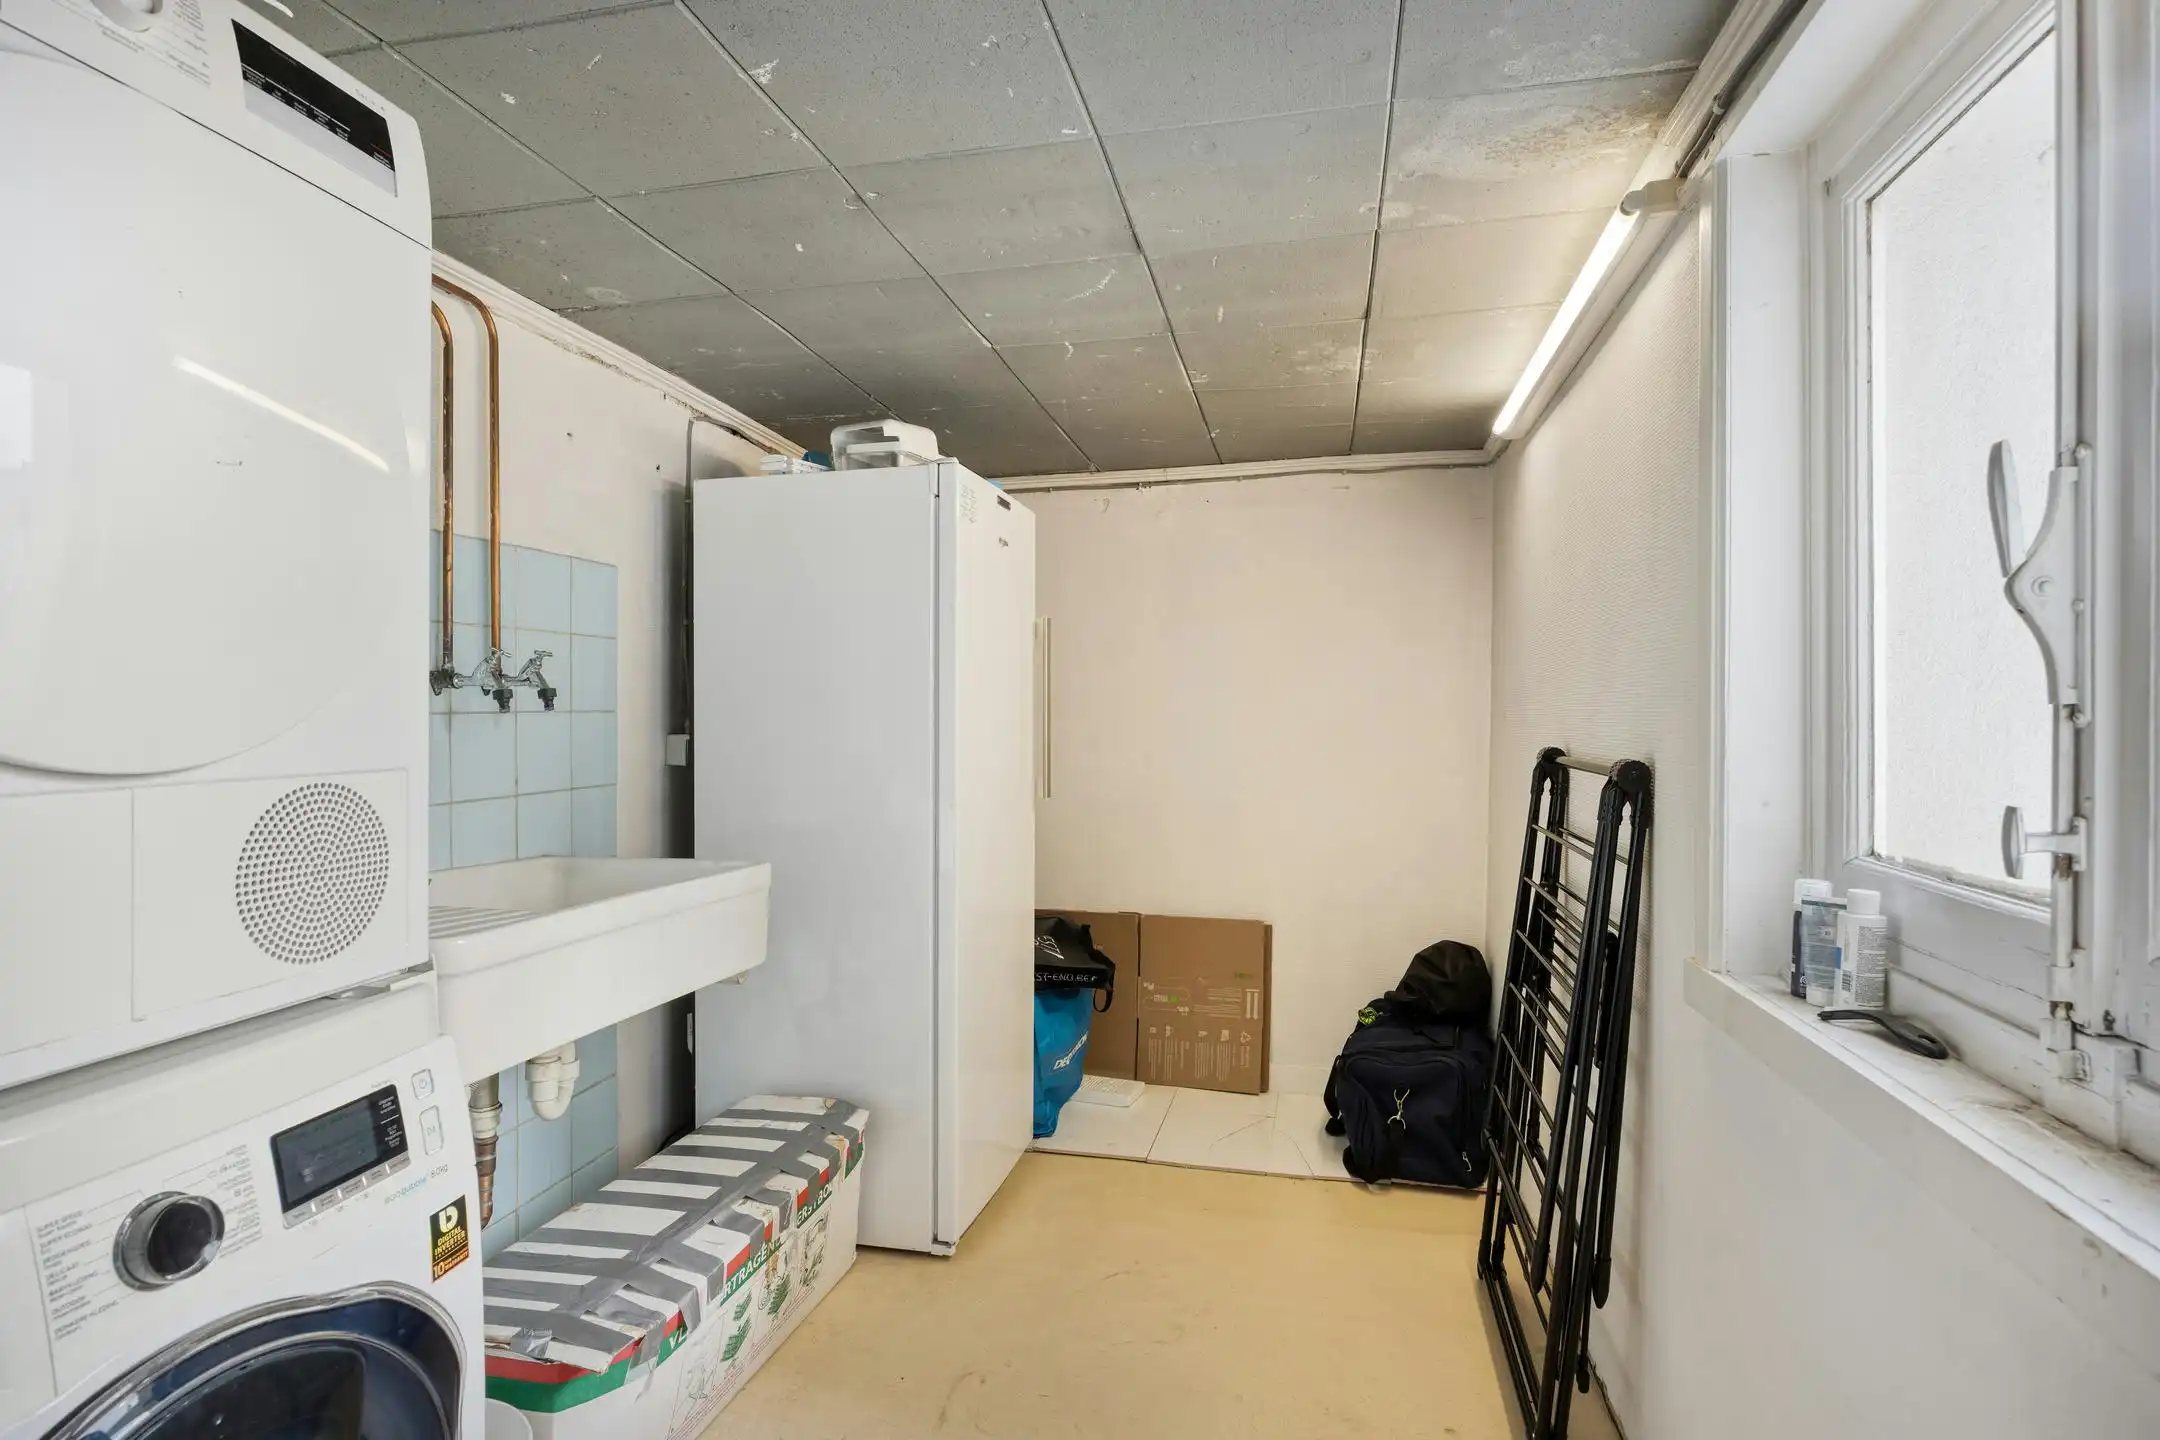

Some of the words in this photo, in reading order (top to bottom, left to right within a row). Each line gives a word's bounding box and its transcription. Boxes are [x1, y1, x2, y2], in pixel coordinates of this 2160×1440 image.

[434, 1230, 466, 1256] INVERTER
[437, 1225, 462, 1246] DIGITAL
[432, 1261, 446, 1279] 10
[669, 1326, 688, 1350] VL
